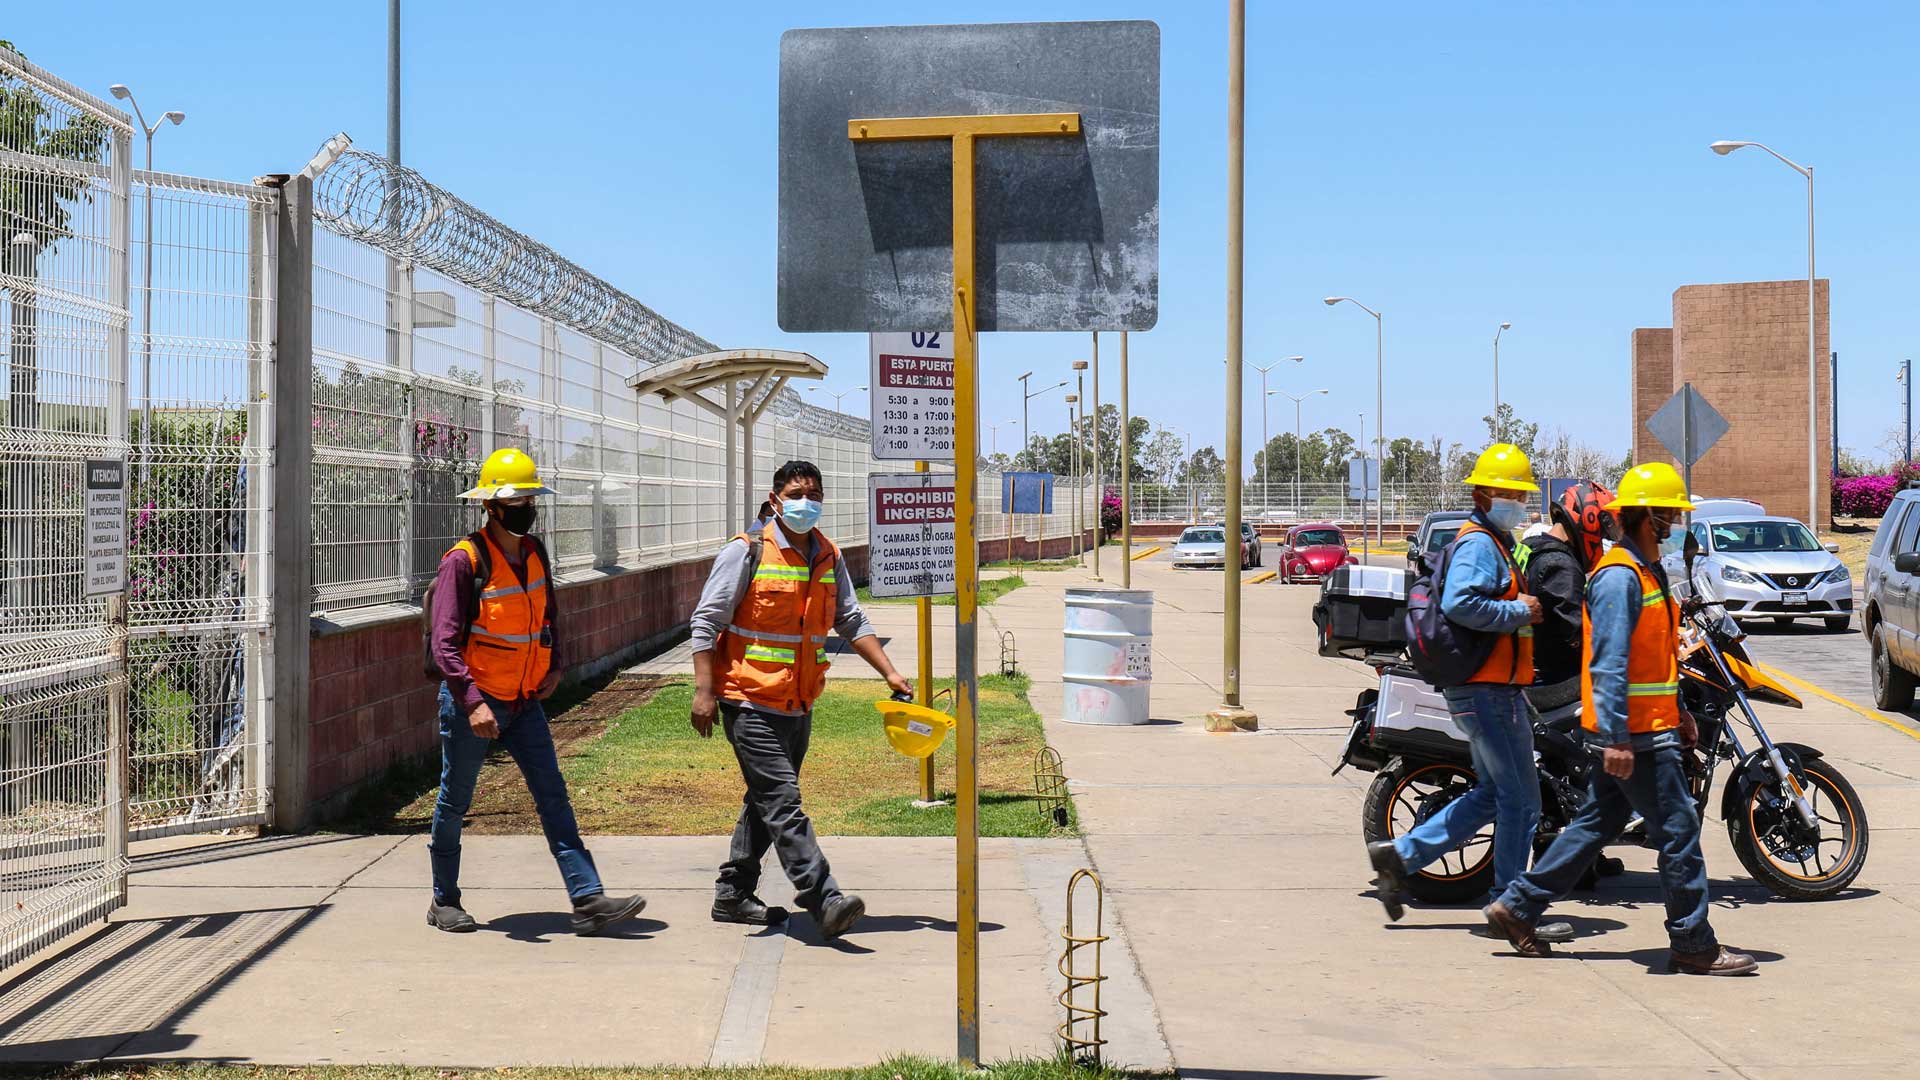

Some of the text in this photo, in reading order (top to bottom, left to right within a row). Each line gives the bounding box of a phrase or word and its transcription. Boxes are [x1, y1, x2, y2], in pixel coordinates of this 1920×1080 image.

[912, 331, 940, 348] 02
[891, 358, 955, 372] ESTA PUERT
[890, 374, 903, 384] SE
[888, 395, 908, 405] 5:30
[929, 396, 948, 406] 9:00
[883, 410, 908, 420] 13:30
[924, 412, 948, 420] 17:00
[883, 426, 908, 434] 21:30
[924, 426, 949, 435] 23:00
[888, 440, 908, 449] 1:00
[884, 533, 920, 543] CAMARAS
[884, 546, 954, 558] CAMARAS DE VIDEO
[884, 562, 920, 572] AGENDAS
[922, 561, 936, 570] CON
